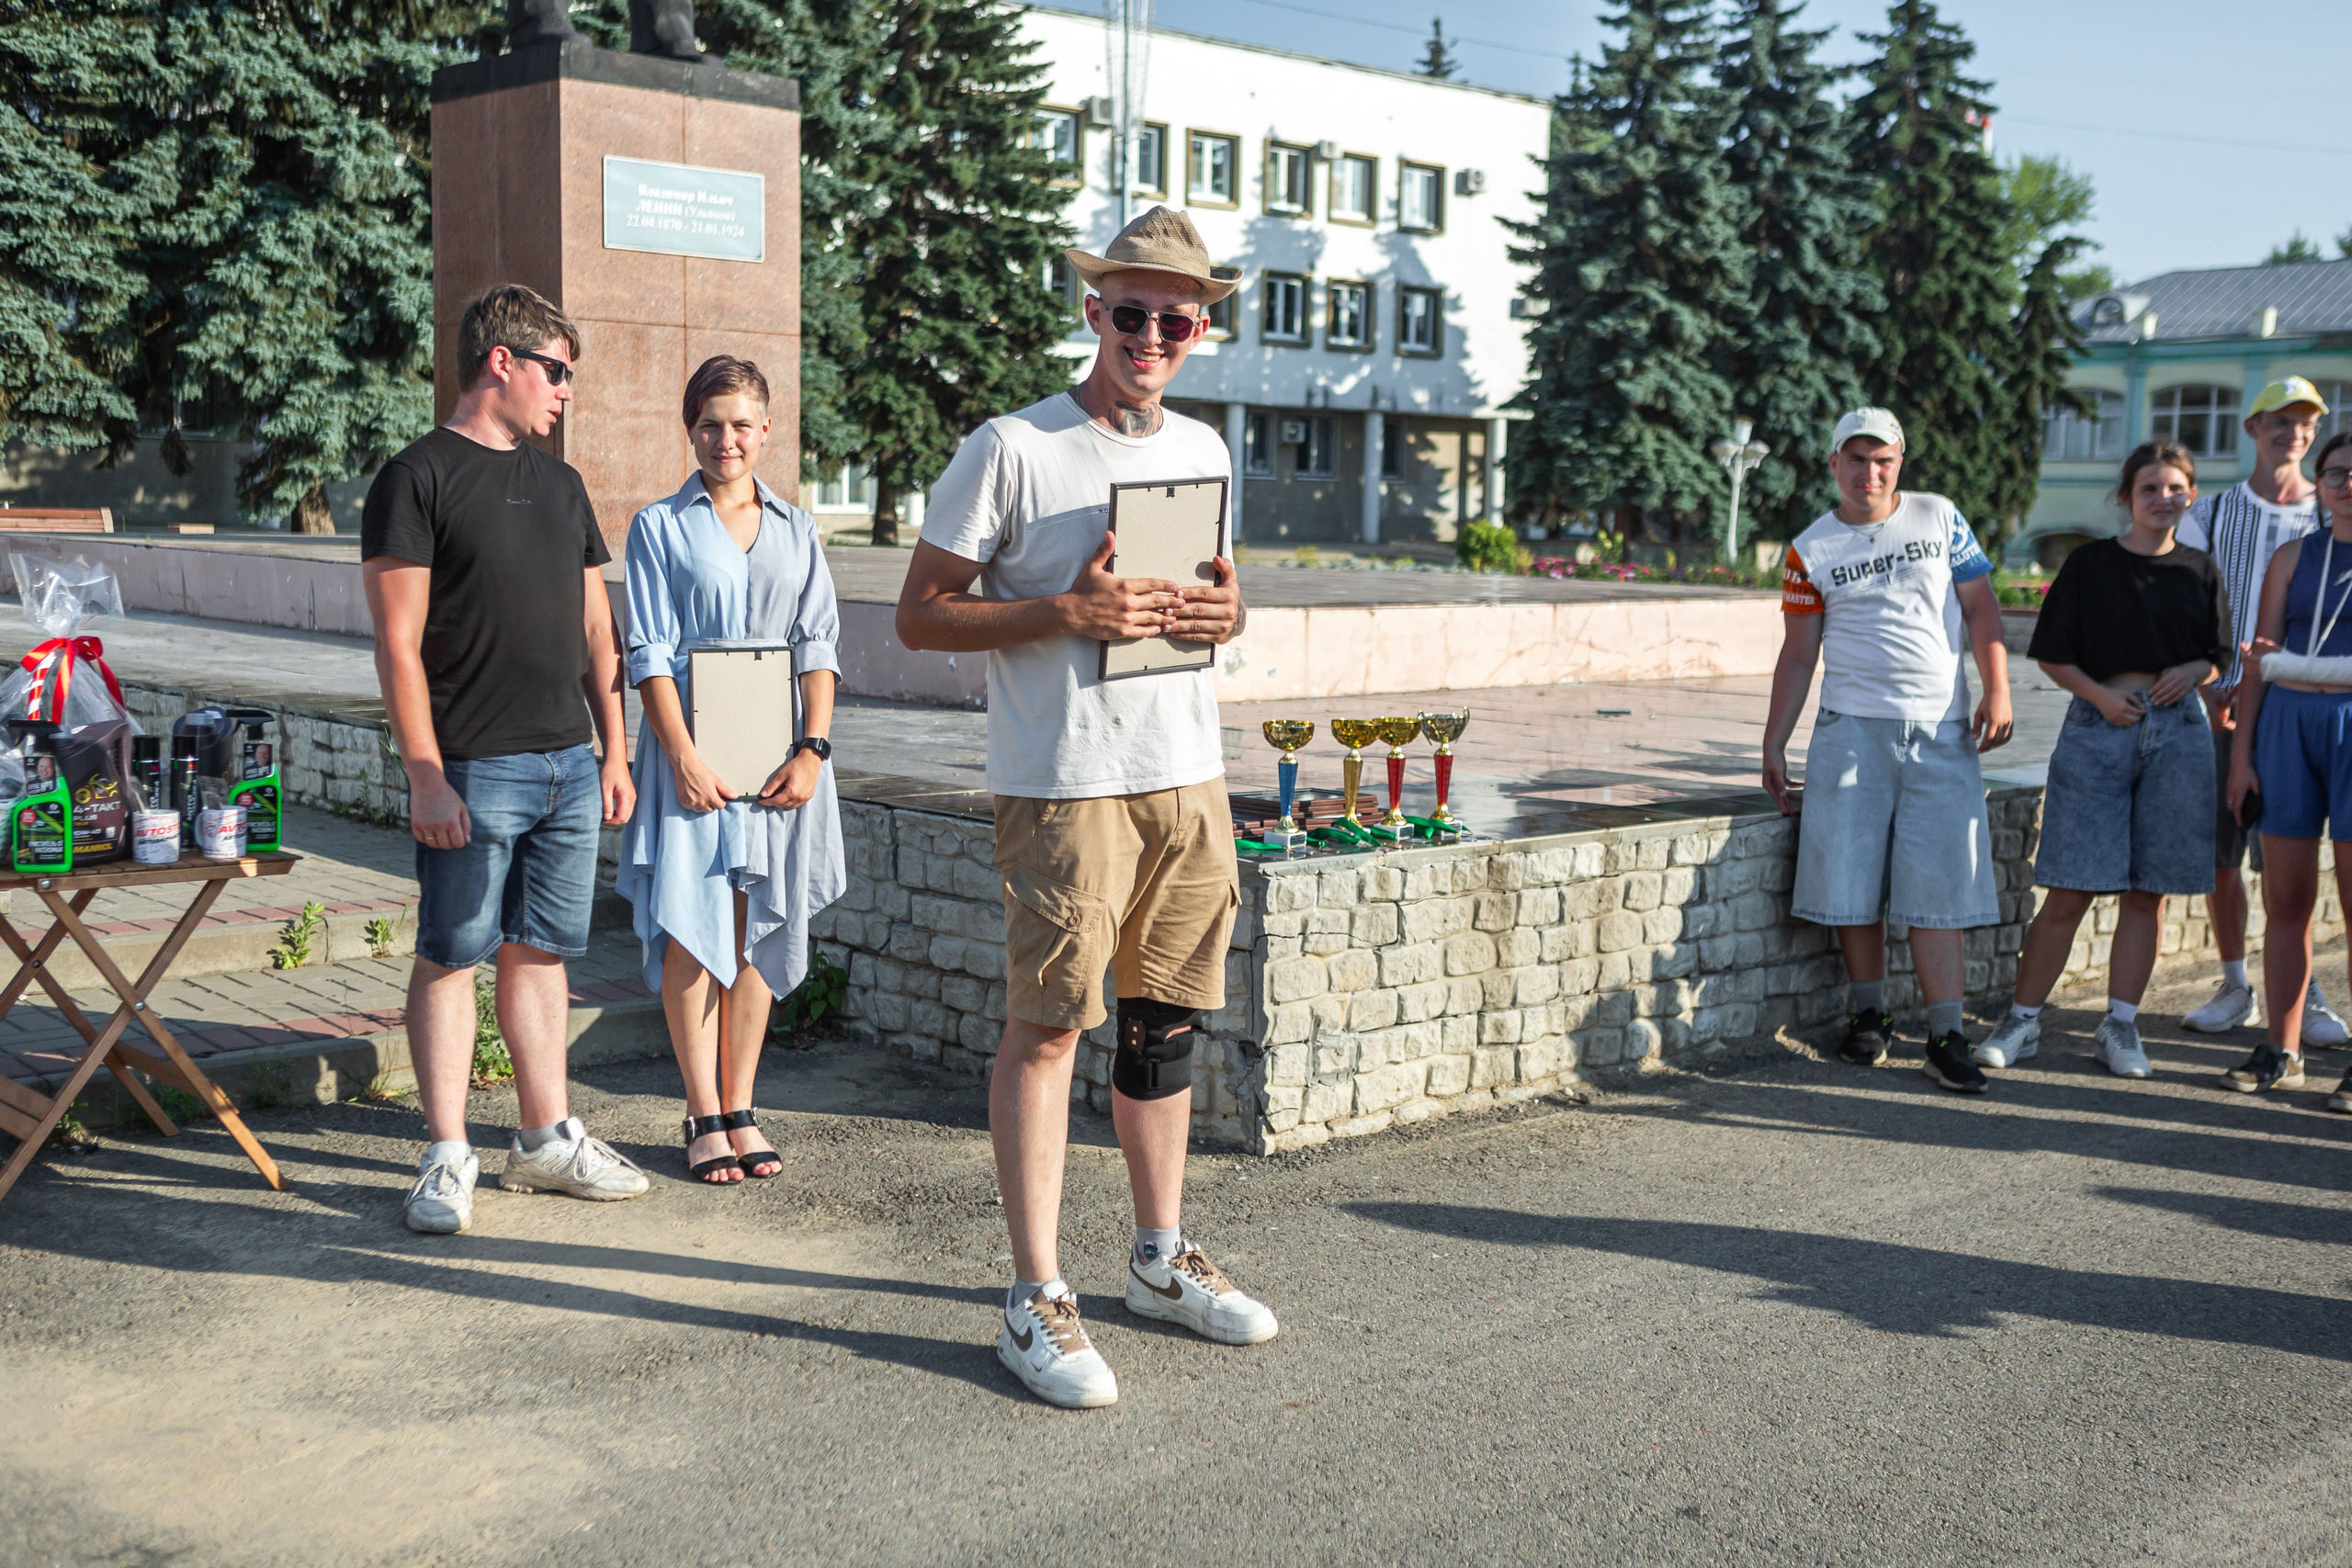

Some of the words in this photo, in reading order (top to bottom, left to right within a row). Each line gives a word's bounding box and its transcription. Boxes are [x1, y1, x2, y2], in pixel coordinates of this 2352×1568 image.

[636, 199, 683, 216] ЛЕНИН
[626, 212, 683, 231] 22.04.1870
[690, 220, 745, 237] 21.01.1924
[1831, 539, 1942, 588] Super-Sky
[74, 800, 121, 814] 4-TAKT
[73, 814, 98, 822] PLUS
